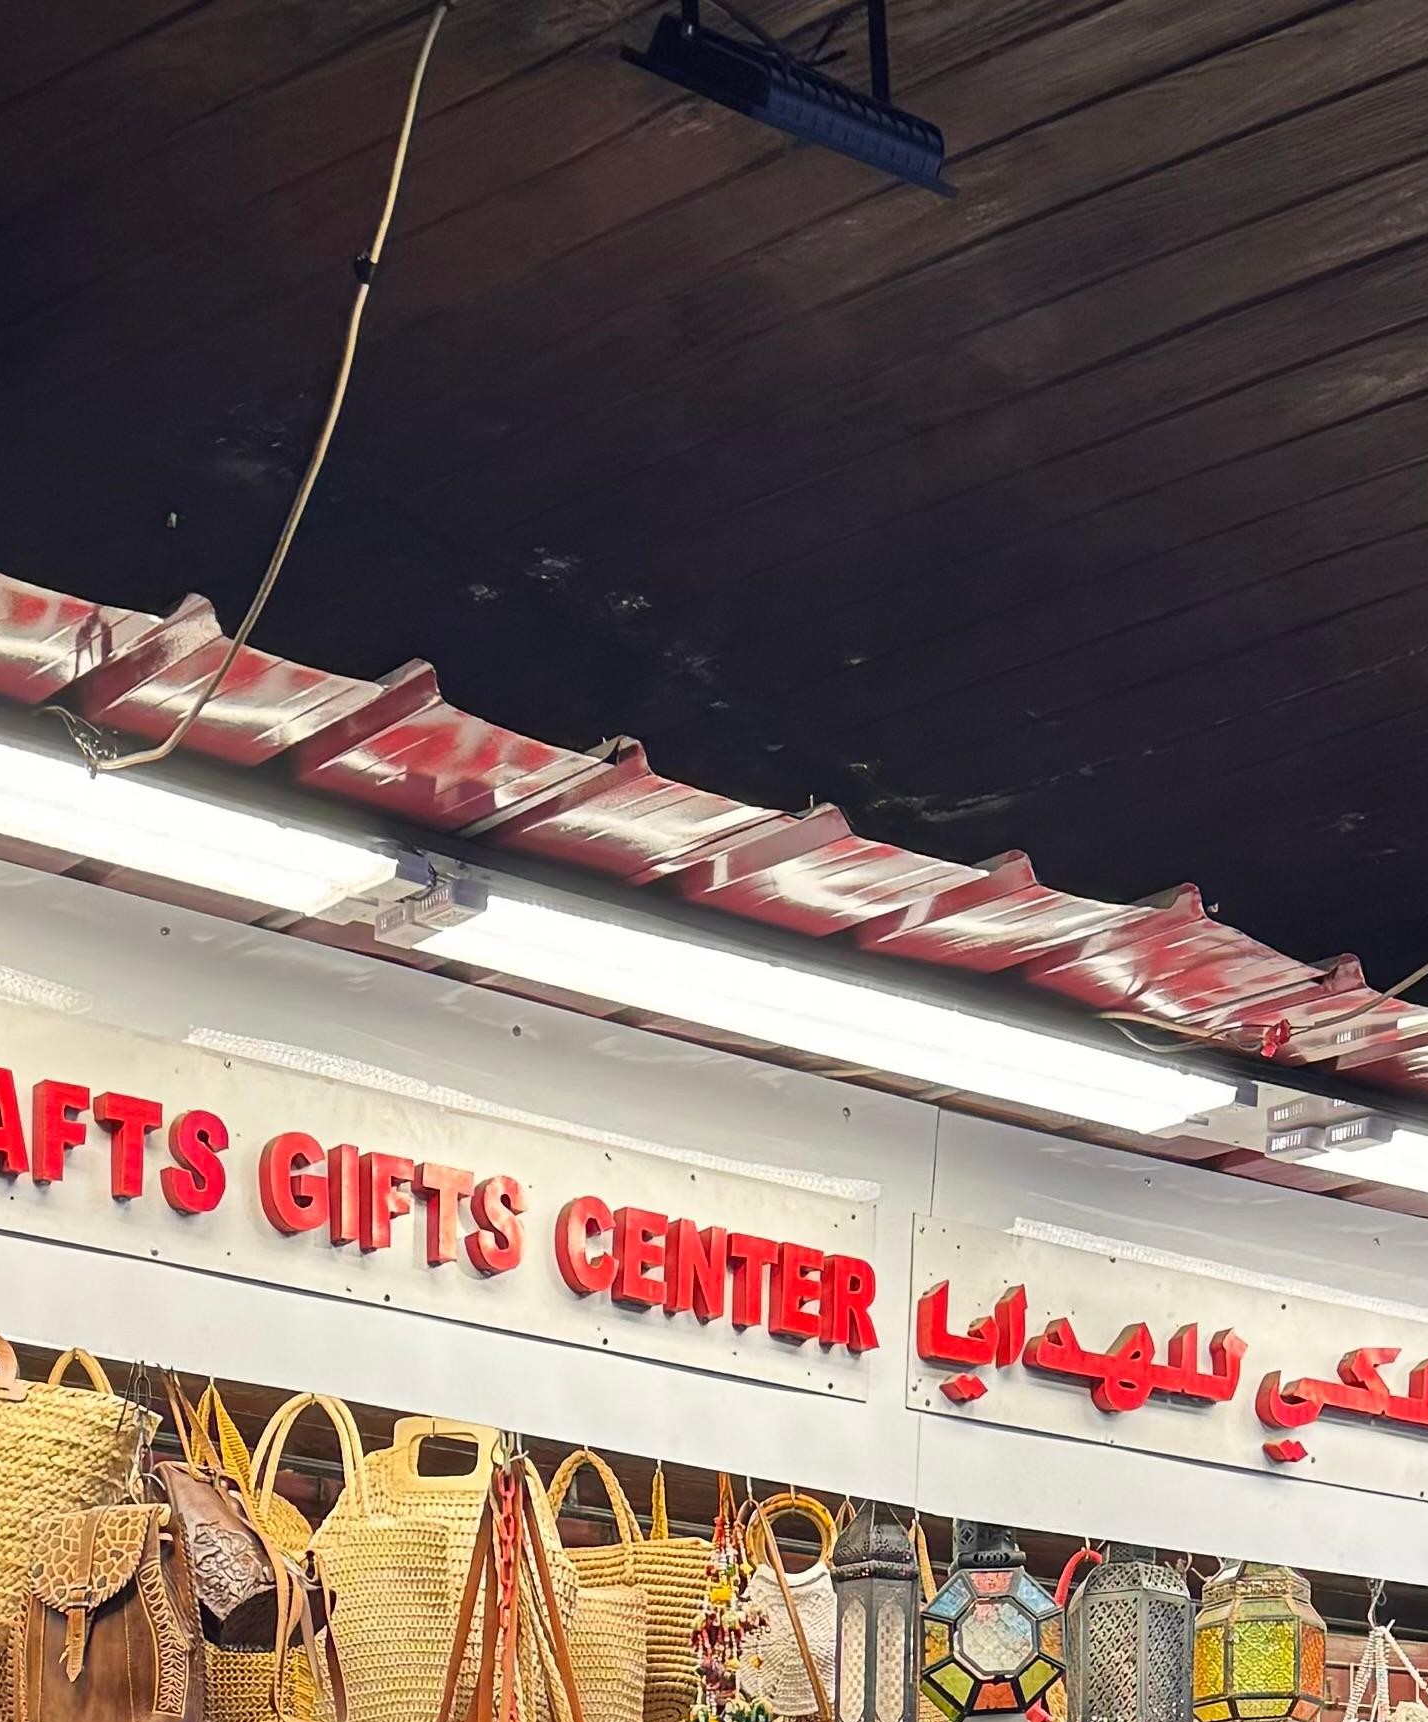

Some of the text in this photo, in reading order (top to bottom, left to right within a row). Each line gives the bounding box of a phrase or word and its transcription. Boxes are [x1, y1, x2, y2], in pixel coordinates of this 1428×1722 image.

[259, 1131, 526, 1277] GIFTS
[555, 1196, 879, 1357] CENTER
[916, 1279, 1249, 1413] للهدايا
